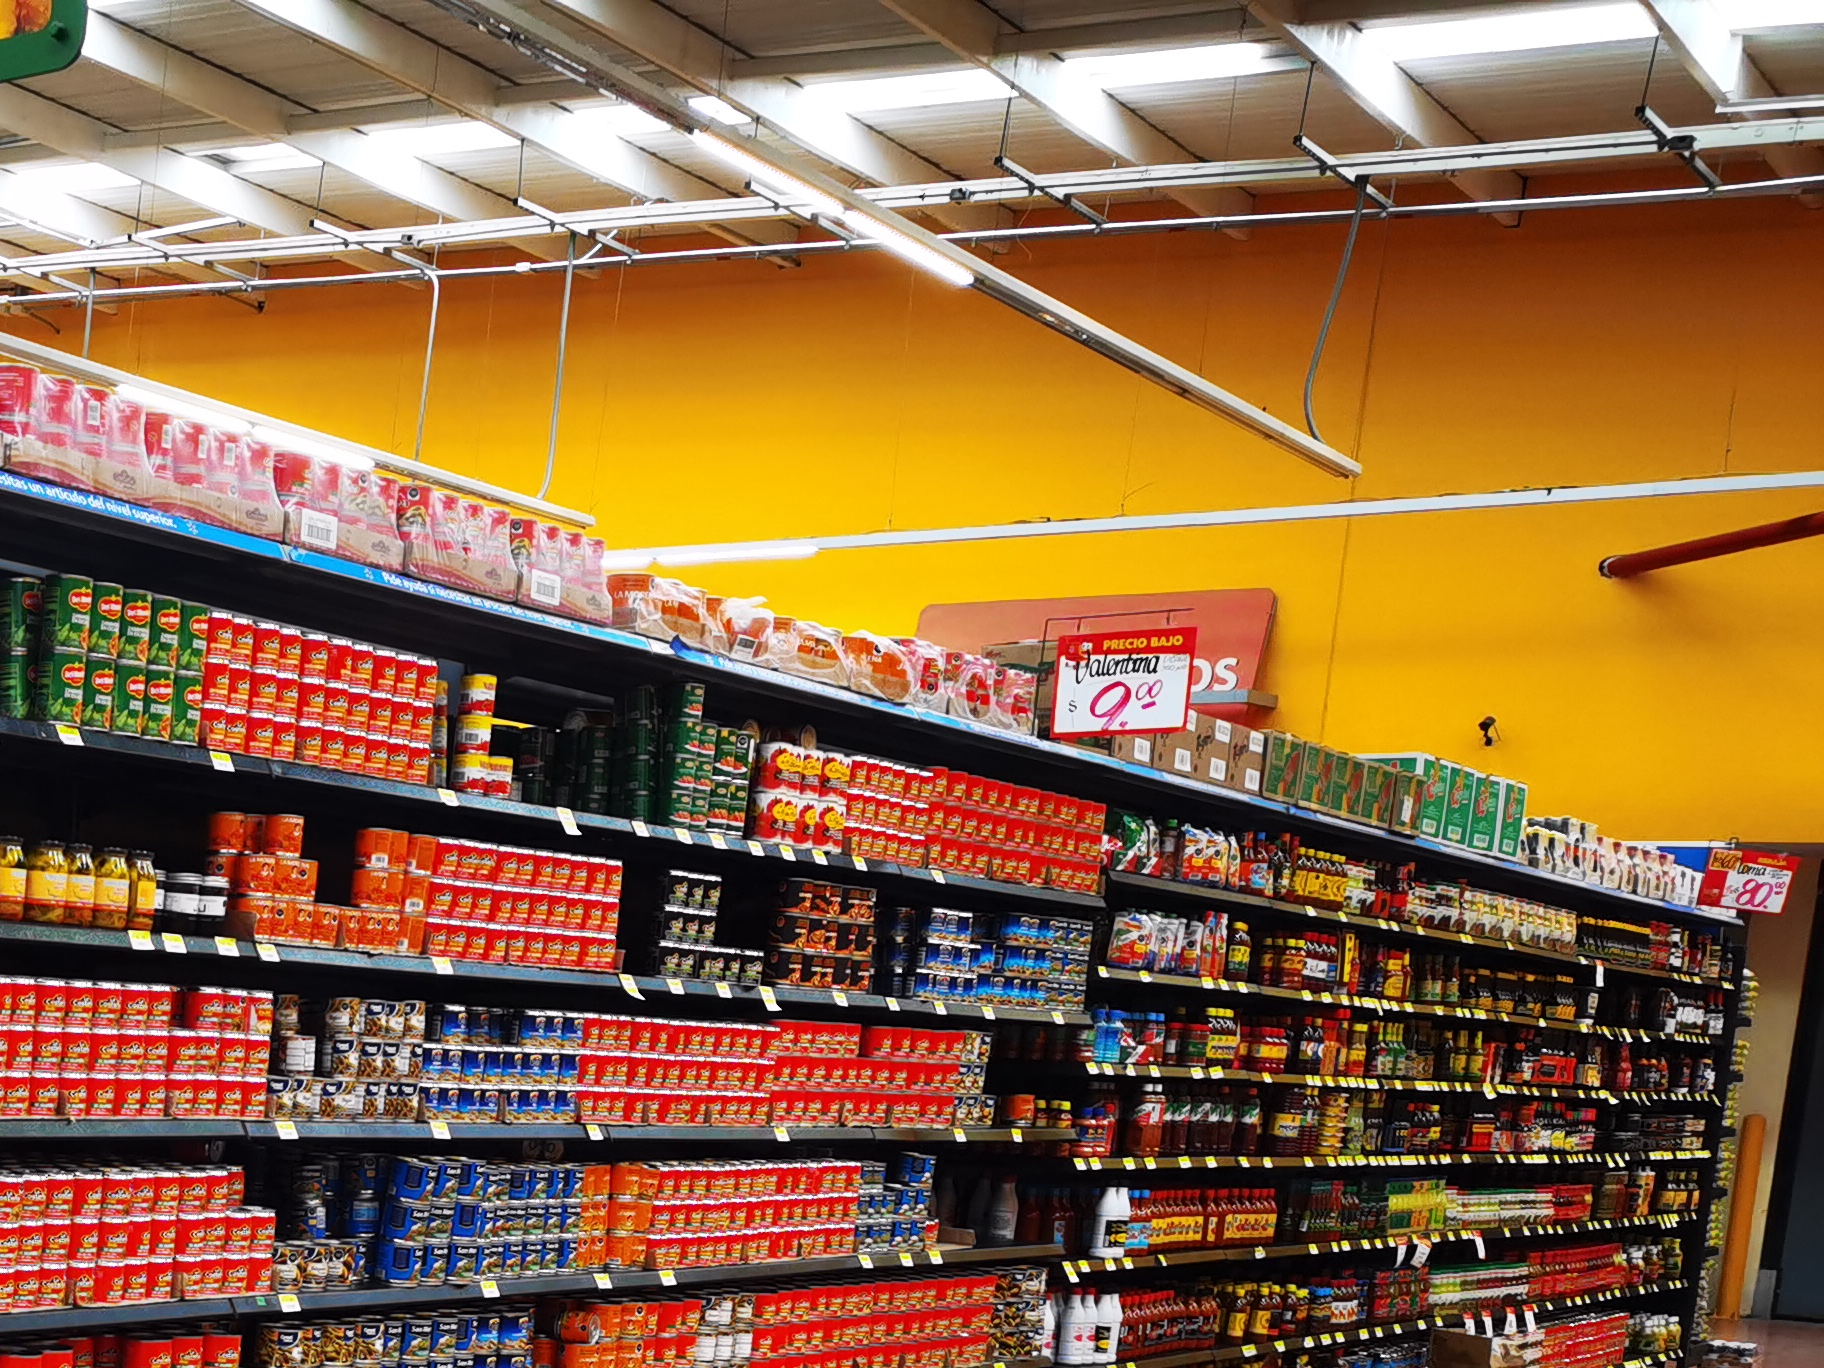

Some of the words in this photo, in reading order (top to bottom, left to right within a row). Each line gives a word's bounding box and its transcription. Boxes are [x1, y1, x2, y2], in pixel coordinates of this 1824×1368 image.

[1103, 638, 1147, 651] PRECIO
[1151, 635, 1183, 647] BAJO
[1075, 650, 1160, 684] Valentina
